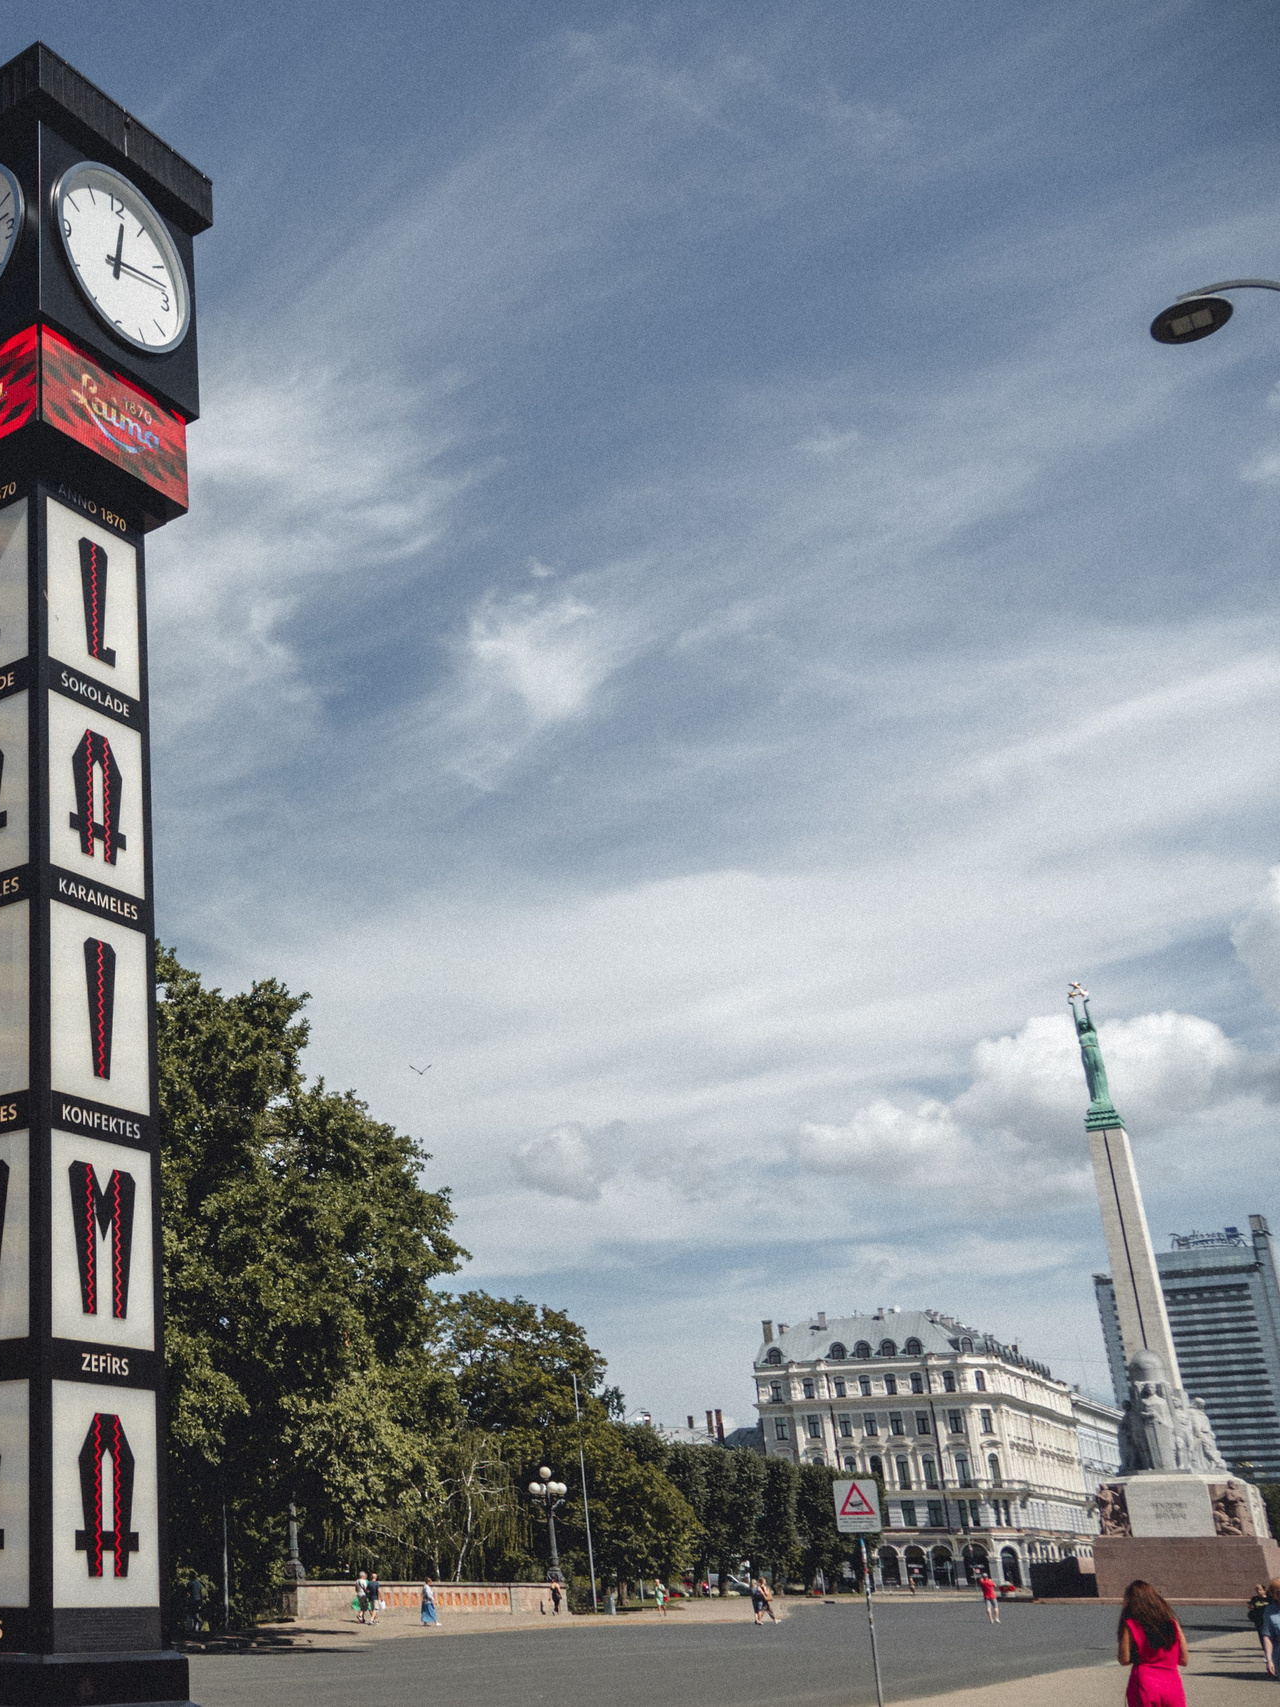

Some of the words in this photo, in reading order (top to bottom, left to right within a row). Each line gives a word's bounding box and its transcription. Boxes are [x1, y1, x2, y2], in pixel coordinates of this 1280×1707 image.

[108, 193, 125, 220] 12
[5, 218, 15, 239] 3
[161, 292, 170, 311] 3
[70, 373, 163, 454] Laima
[123, 397, 152, 425] 1870
[58, 484, 97, 514] ANNO
[100, 507, 127, 532] 1870
[60, 671, 130, 718] ŠOKOLĀDE
[59, 878, 138, 921] KARAMELES
[62, 1103, 141, 1140] KONFEKTES
[81, 1352, 130, 1376] ZEFĪRS
